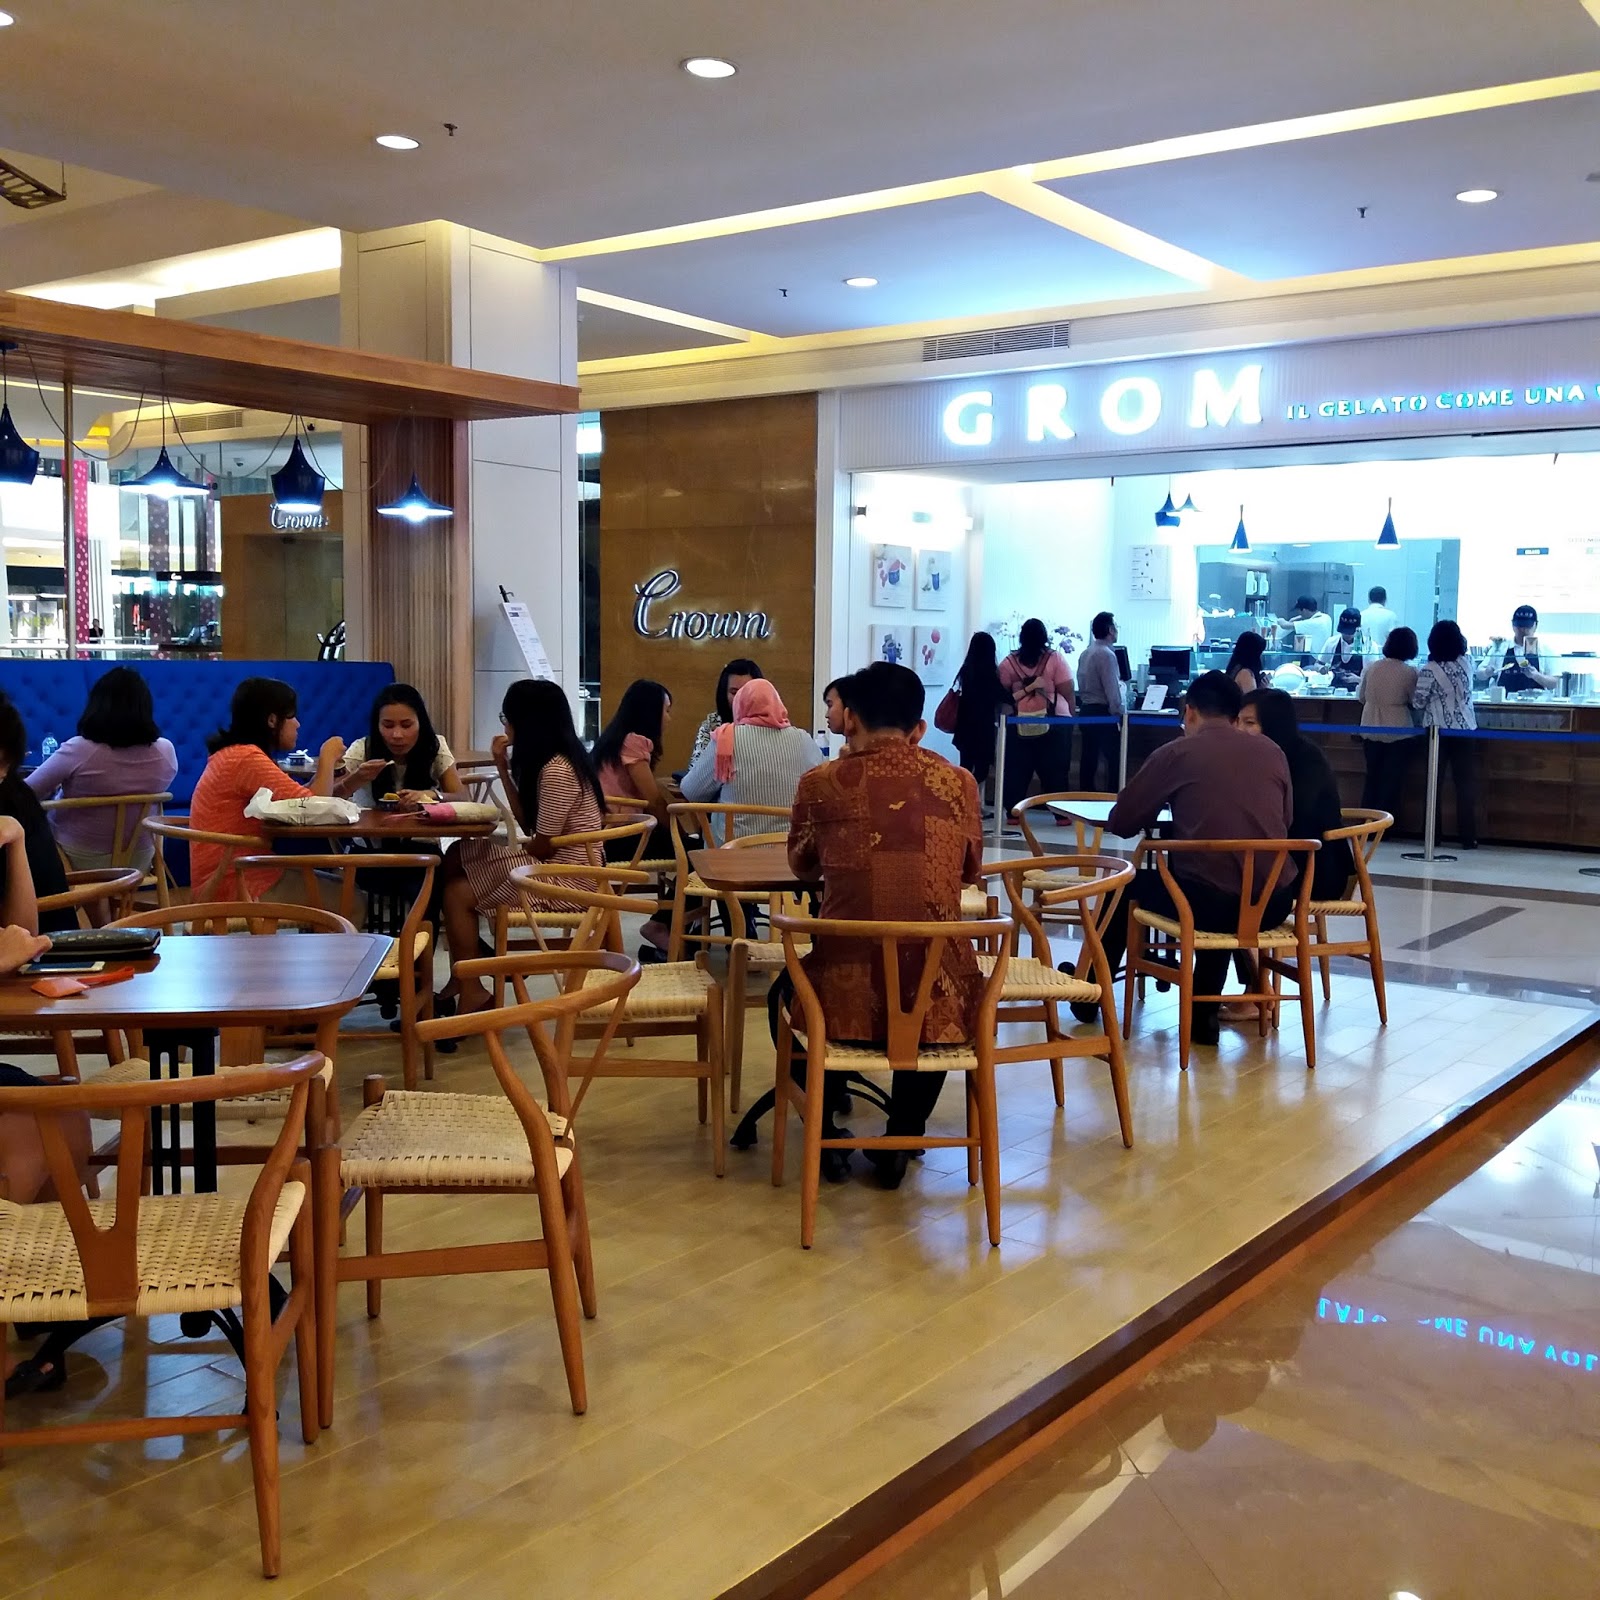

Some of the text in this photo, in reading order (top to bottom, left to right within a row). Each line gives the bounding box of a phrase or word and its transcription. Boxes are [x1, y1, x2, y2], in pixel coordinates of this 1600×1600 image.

[942, 364, 1264, 447] GROM
[1286, 404, 1311, 420] IL
[1317, 395, 1428, 418] GELATO
[1435, 389, 1514, 411] COME
[1525, 384, 1586, 406] UNA
[632, 568, 771, 640] Crown
